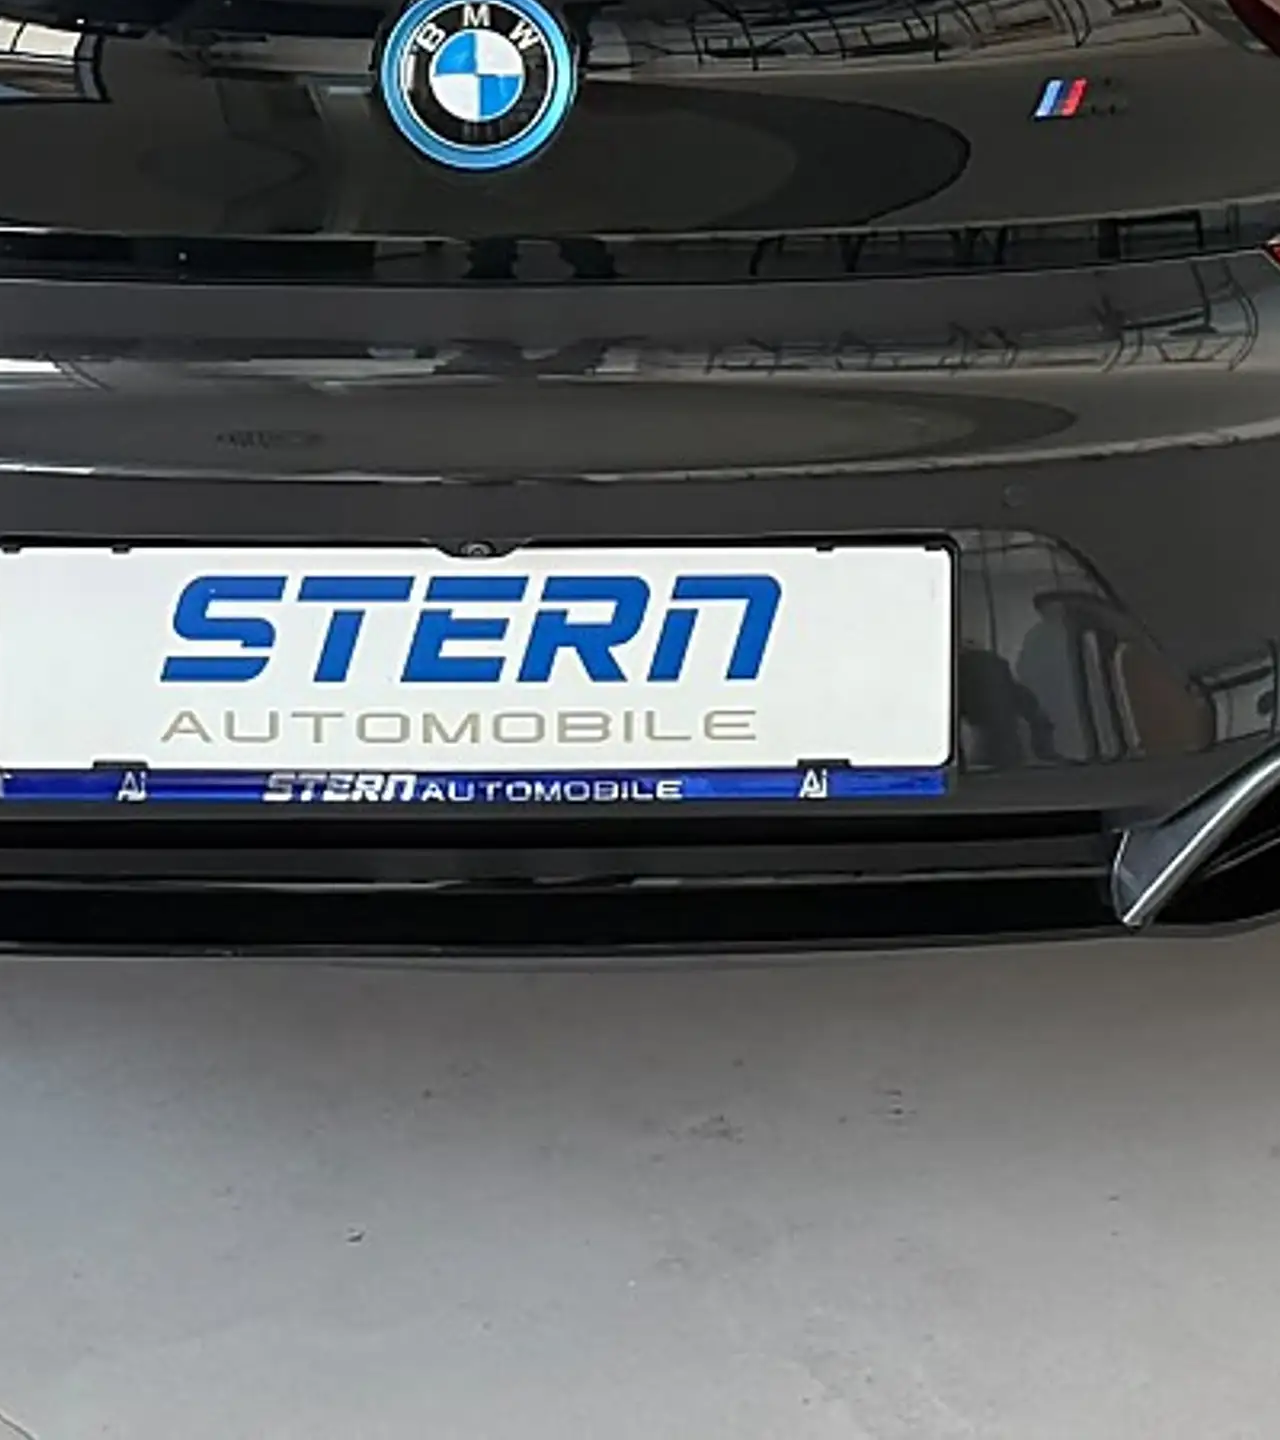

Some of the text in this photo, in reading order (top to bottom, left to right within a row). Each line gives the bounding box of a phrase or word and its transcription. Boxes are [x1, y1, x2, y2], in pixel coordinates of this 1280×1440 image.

[414, 3, 542, 53] BMW
[160, 575, 783, 683] STERN
[160, 709, 758, 745] AUTOMOBILE
[262, 773, 683, 802] STERN AUTOMOBILE
